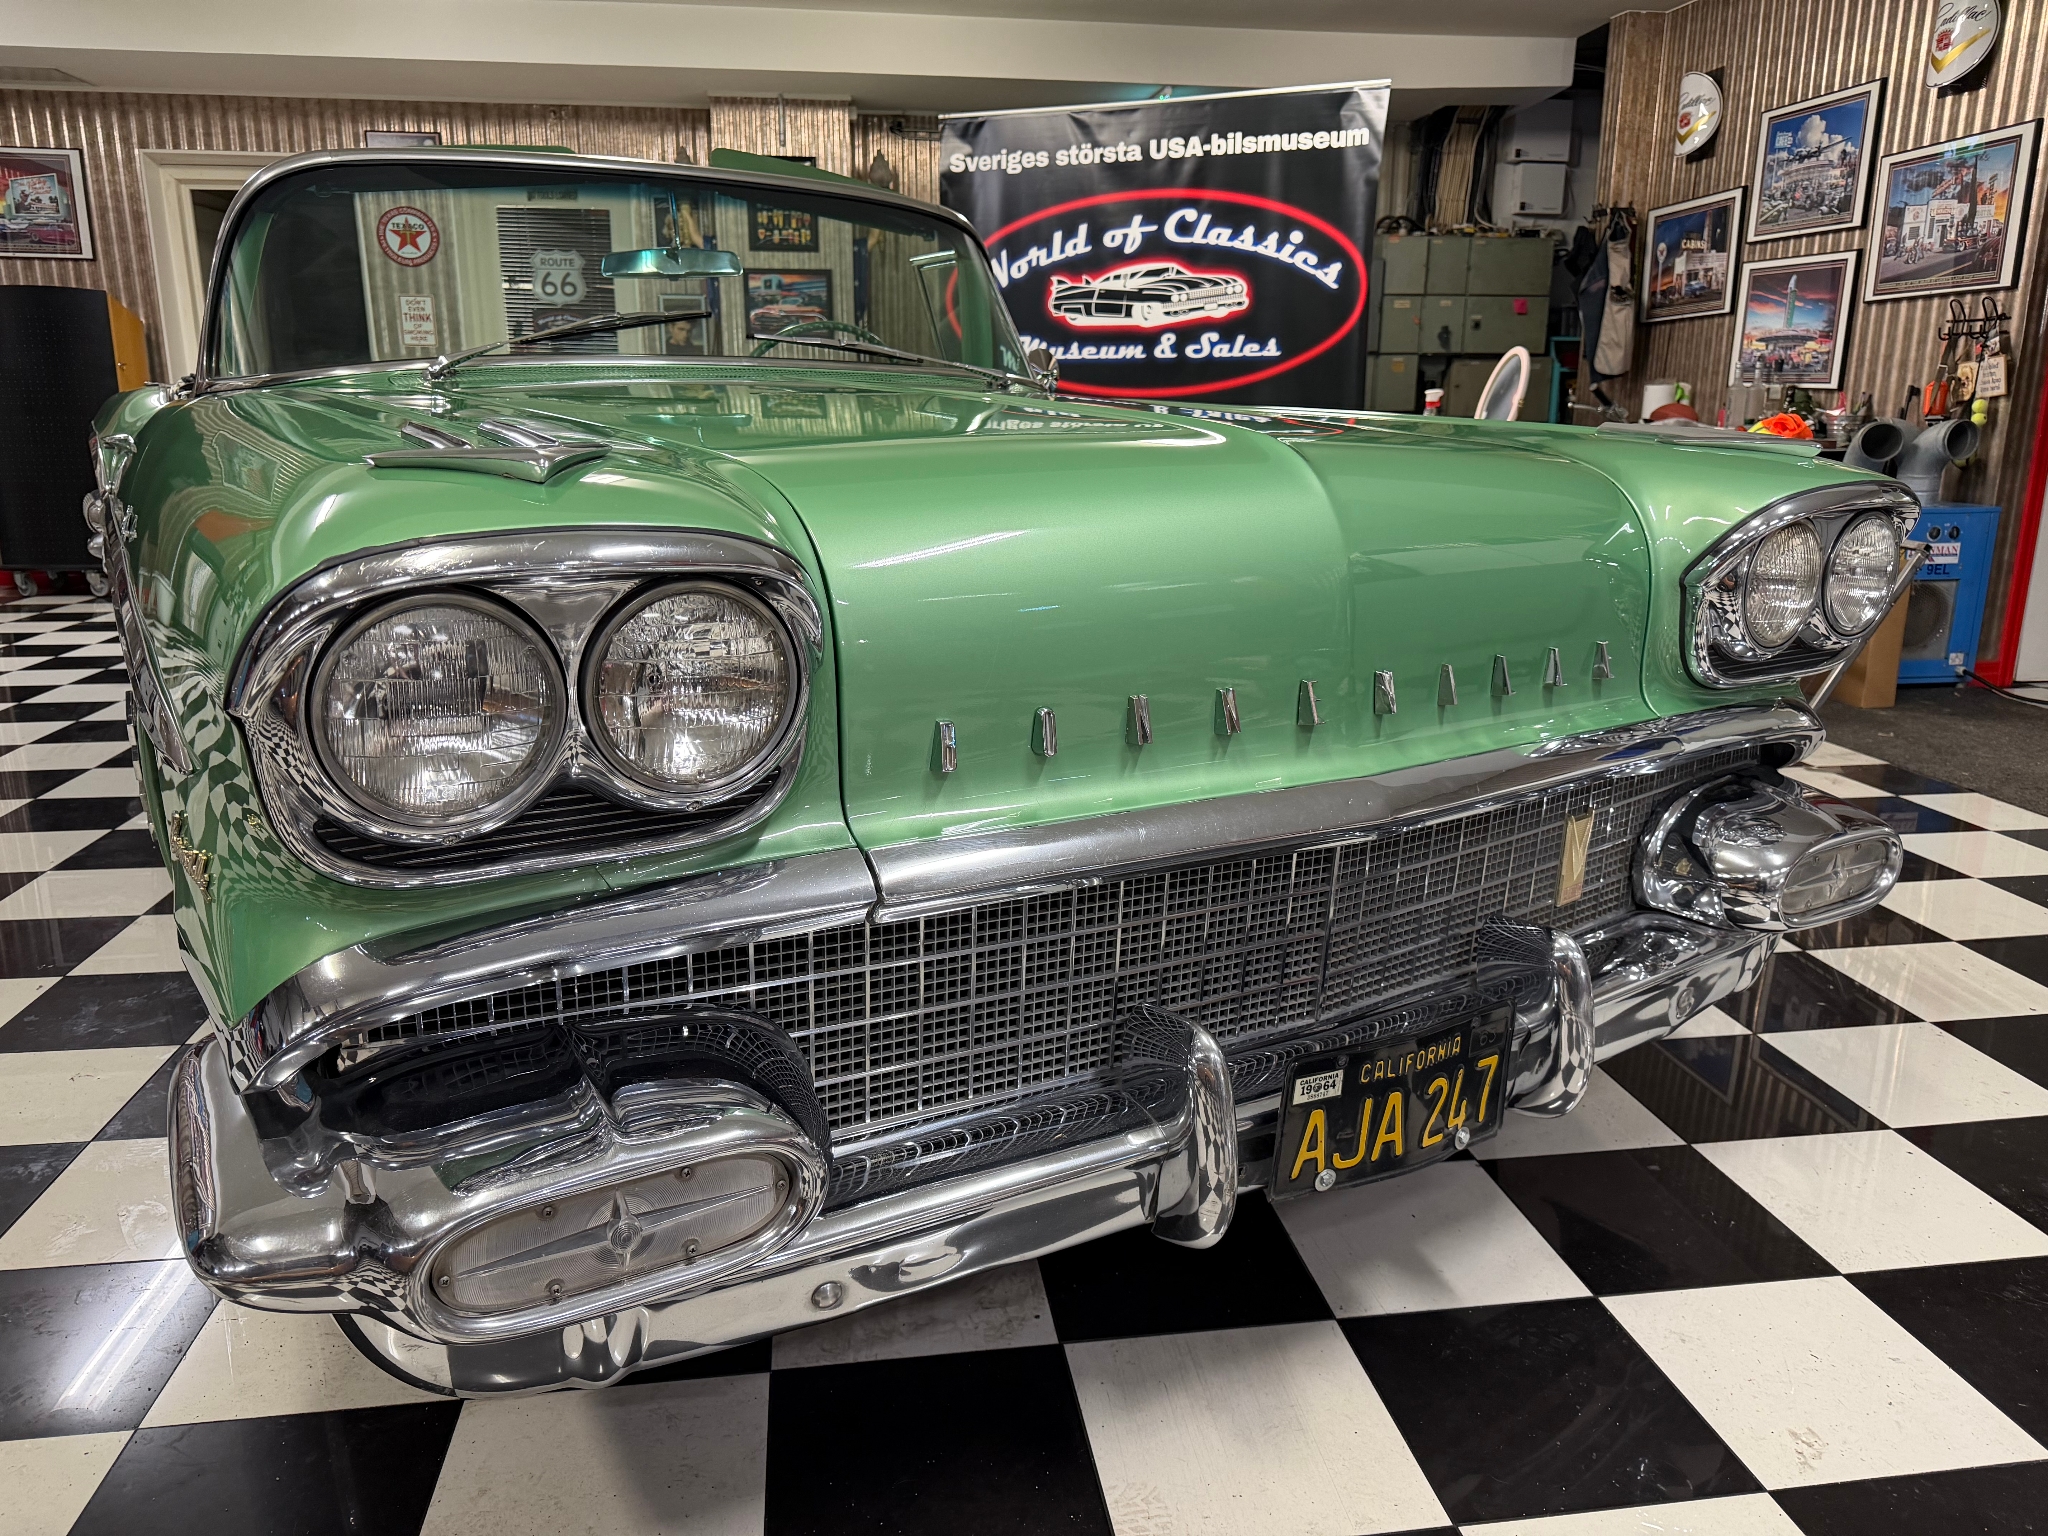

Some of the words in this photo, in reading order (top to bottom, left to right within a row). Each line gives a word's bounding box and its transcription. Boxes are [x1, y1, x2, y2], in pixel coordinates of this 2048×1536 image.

[949, 149, 1049, 175] Sveriges
[1055, 141, 1143, 167] största
[1148, 127, 1370, 161] USA-bilsmuseum
[540, 258, 575, 267] ROUTE
[1103, 214, 1159, 254] of
[1164, 208, 1343, 290] Classics
[541, 271, 577, 297] 66
[403, 312, 432, 323] THINK
[1153, 332, 1178, 359] &
[1184, 331, 1282, 360] Sales
[1360, 1036, 1461, 1083] CALIFORNIA
[1299, 1072, 1339, 1086] CALIFORNIA
[1300, 1084, 1313, 1096] 19
[1322, 1079, 1337, 1091] 64
[1290, 1091, 1404, 1180] AJA
[1421, 1054, 1499, 1149] 247
